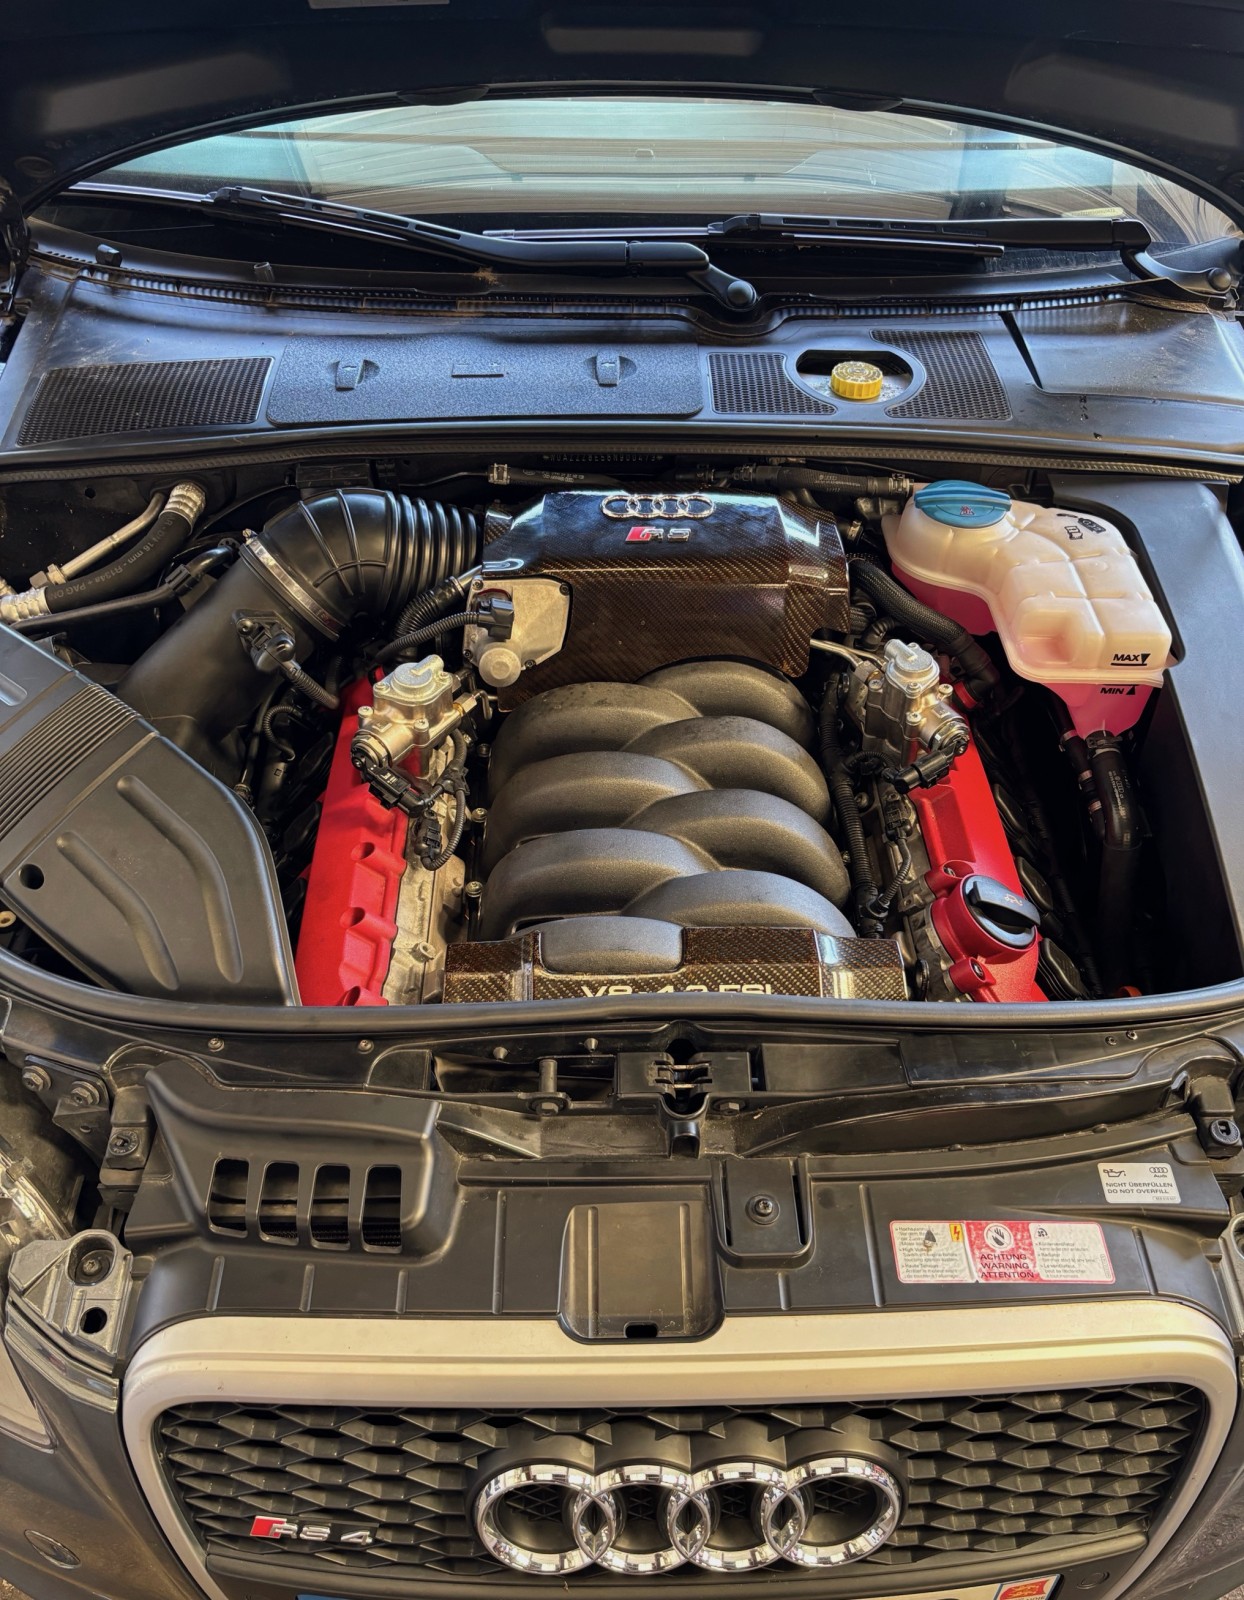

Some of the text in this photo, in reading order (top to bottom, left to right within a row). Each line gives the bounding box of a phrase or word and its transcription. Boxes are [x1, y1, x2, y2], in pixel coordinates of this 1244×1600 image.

[1113, 653, 1140, 662] MAX
[1100, 687, 1125, 695] MIN
[980, 1271, 1035, 1279] ATTENTION
